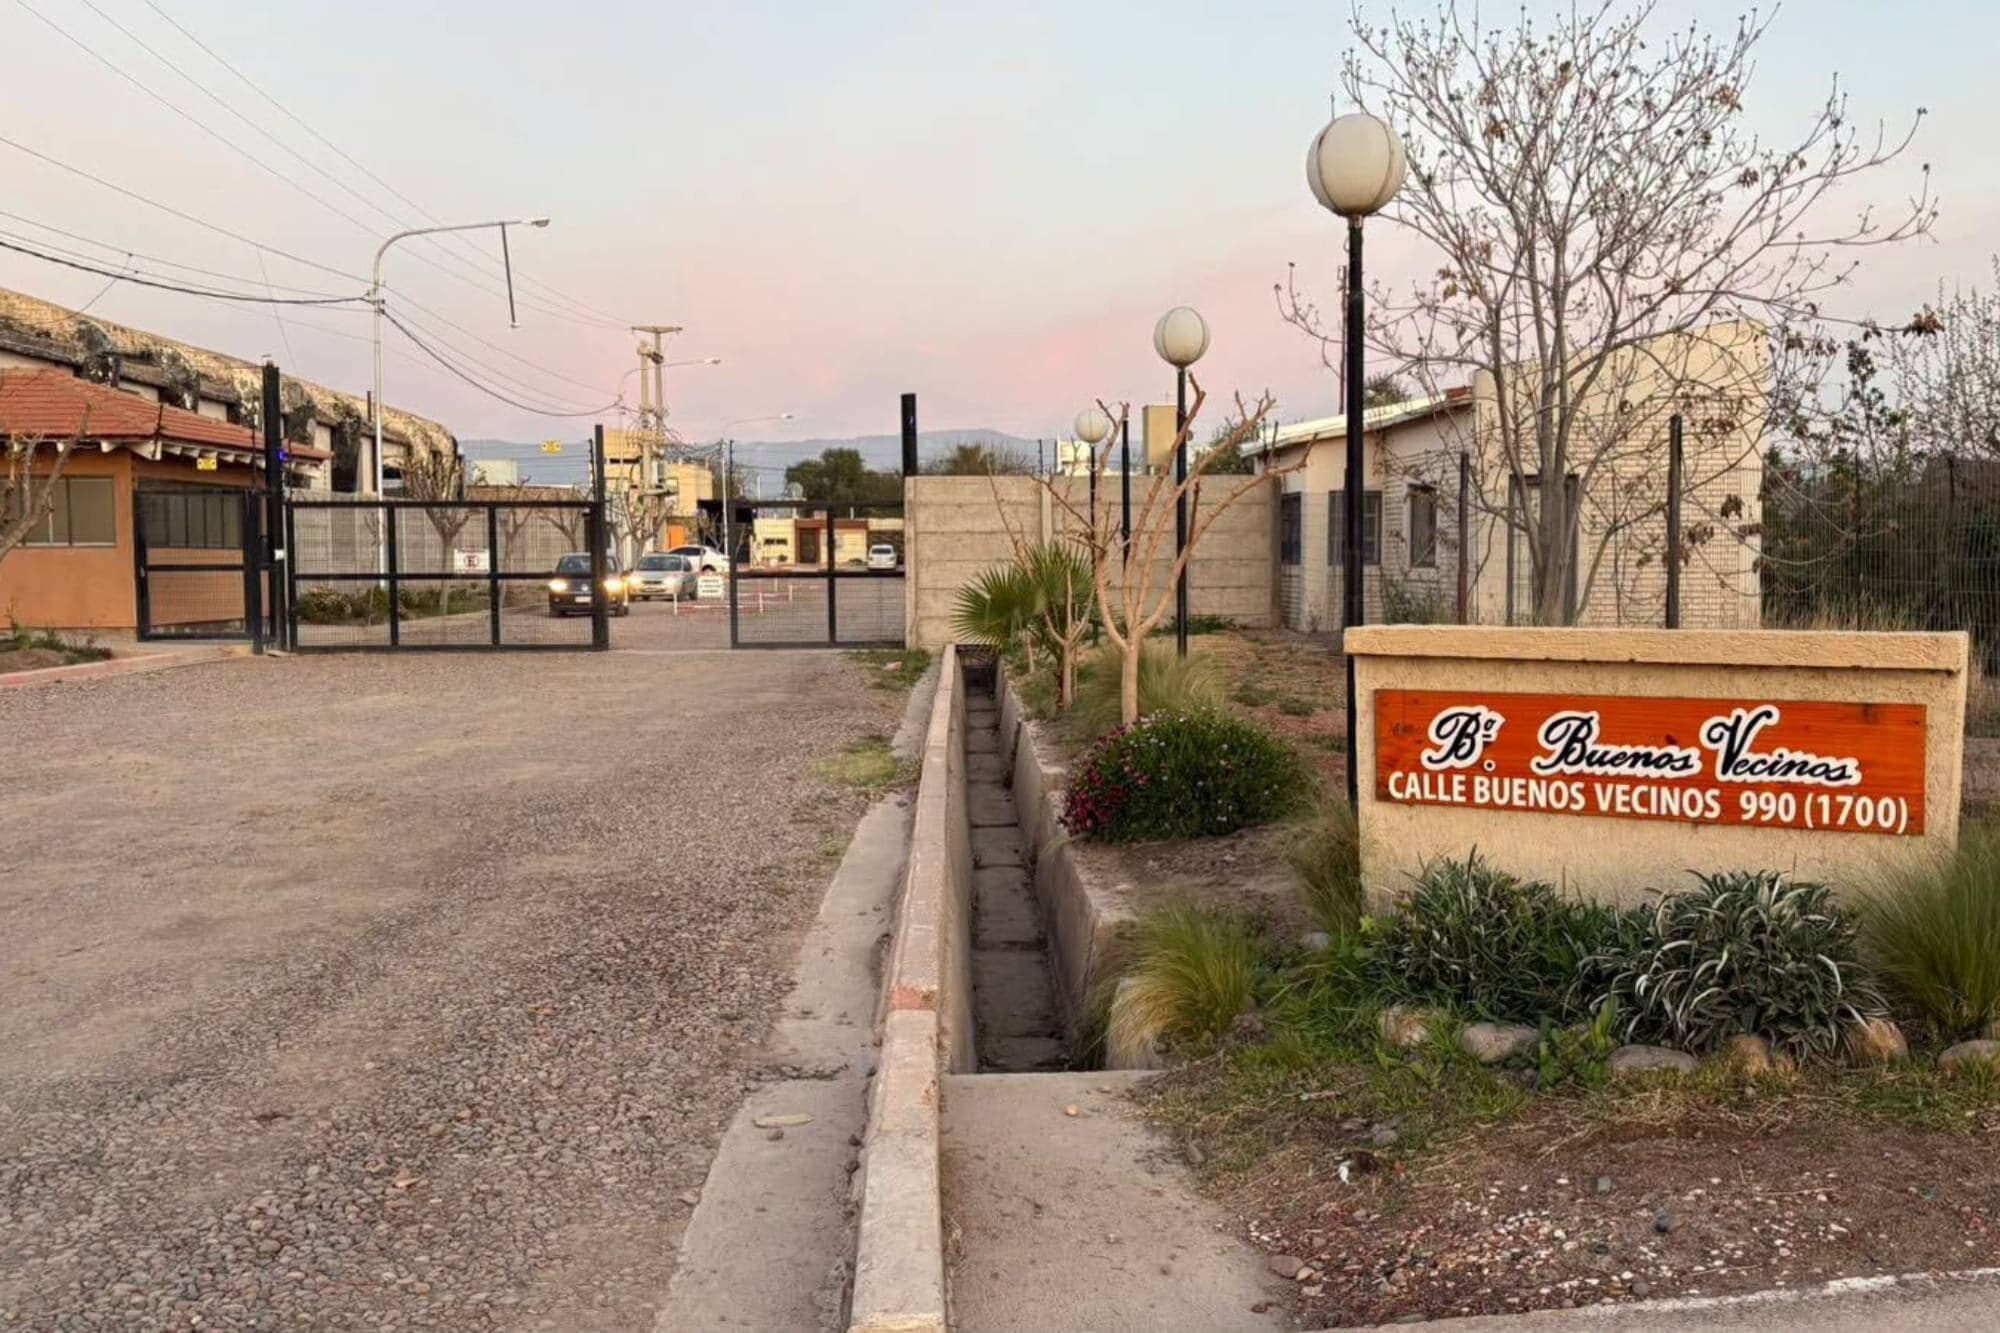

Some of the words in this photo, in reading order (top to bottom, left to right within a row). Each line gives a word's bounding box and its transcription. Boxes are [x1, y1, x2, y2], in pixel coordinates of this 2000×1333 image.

[1533, 711, 1700, 776] Buenos
[1702, 707, 1860, 783] Vecinos
[1388, 771, 1466, 802] CALLE
[1474, 776, 1586, 811] BUENOS
[1593, 783, 1721, 819] VECINOS
[1739, 791, 1797, 823] 990
[1805, 793, 1909, 834] (1700)
